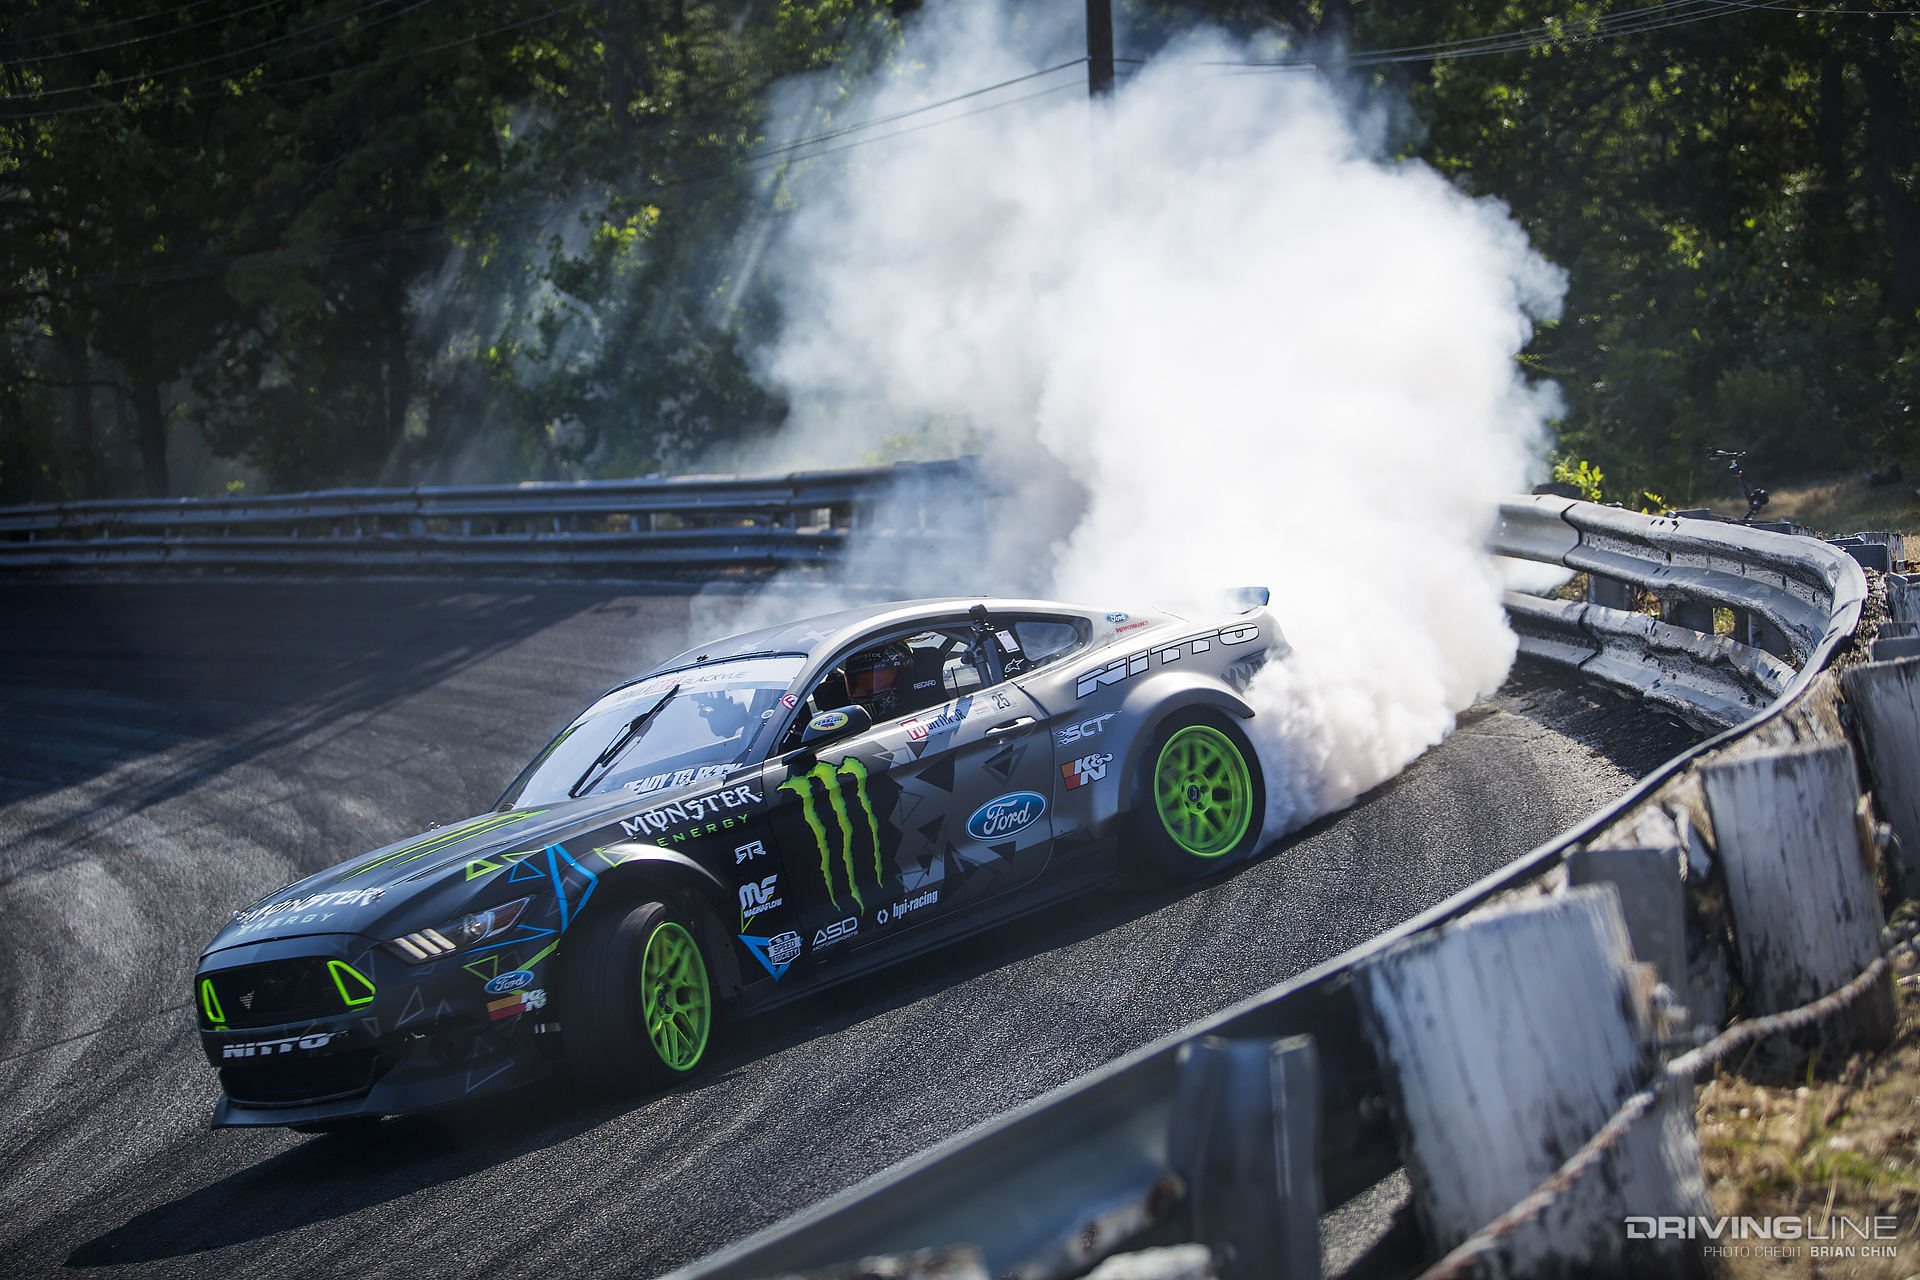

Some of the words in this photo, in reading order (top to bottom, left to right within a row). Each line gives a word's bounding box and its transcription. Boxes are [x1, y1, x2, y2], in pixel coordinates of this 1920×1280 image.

[1076, 622, 1260, 701] NITTO
[913, 679, 937, 691] RECARO
[991, 693, 1011, 710] 25
[1055, 712, 1120, 747] SCT
[619, 784, 763, 837] MONSTER
[983, 799, 1031, 835] Ford
[656, 813, 748, 848] ENERGY
[743, 897, 783, 919] MAGNAFLOW
[235, 911, 340, 937] ENERGY
[812, 916, 858, 946] ASD
[772, 948, 798, 963] SOCIETY
[494, 973, 526, 992] Ford
[222, 1033, 331, 1059] NITTO
